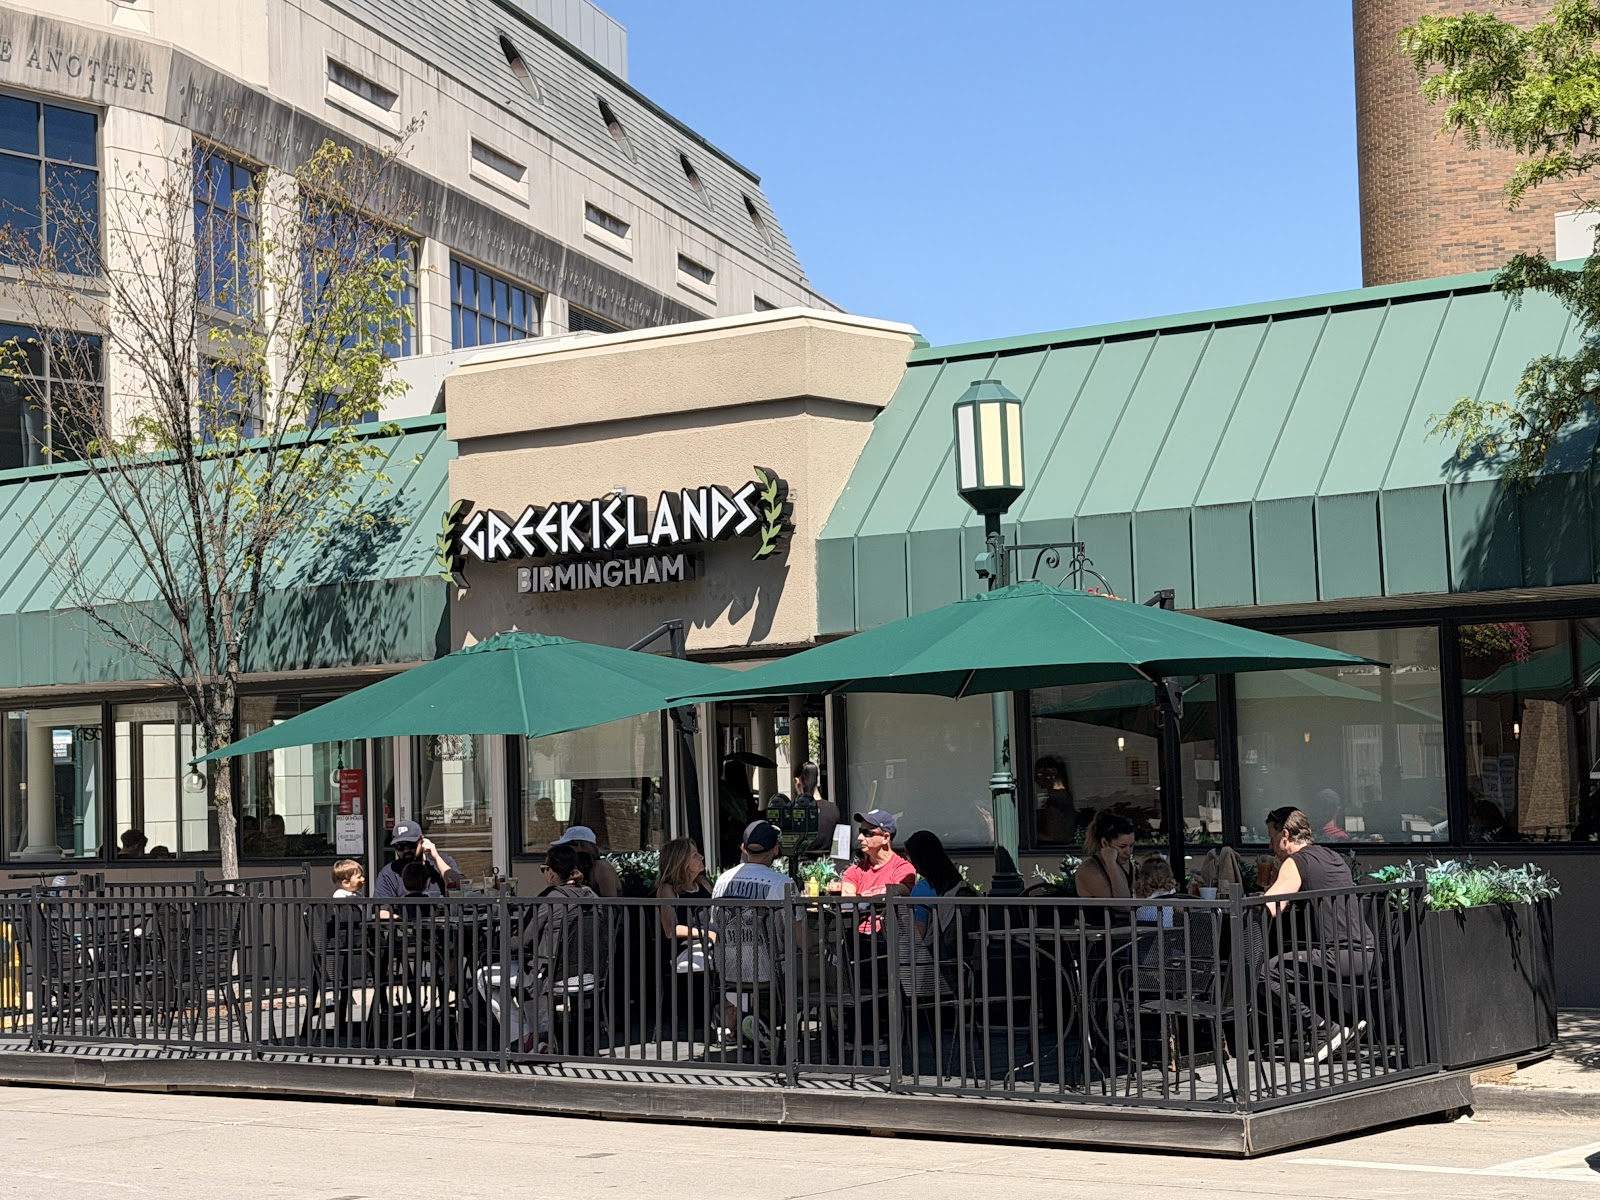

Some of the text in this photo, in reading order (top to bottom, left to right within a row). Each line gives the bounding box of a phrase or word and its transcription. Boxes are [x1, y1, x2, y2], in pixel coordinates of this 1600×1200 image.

[26, 42, 155, 95] ANOTHER
[509, 243, 550, 271] PICTURE
[461, 482, 759, 561] GREEK ISLANDS
[517, 554, 686, 593] BIRMINGHAM
